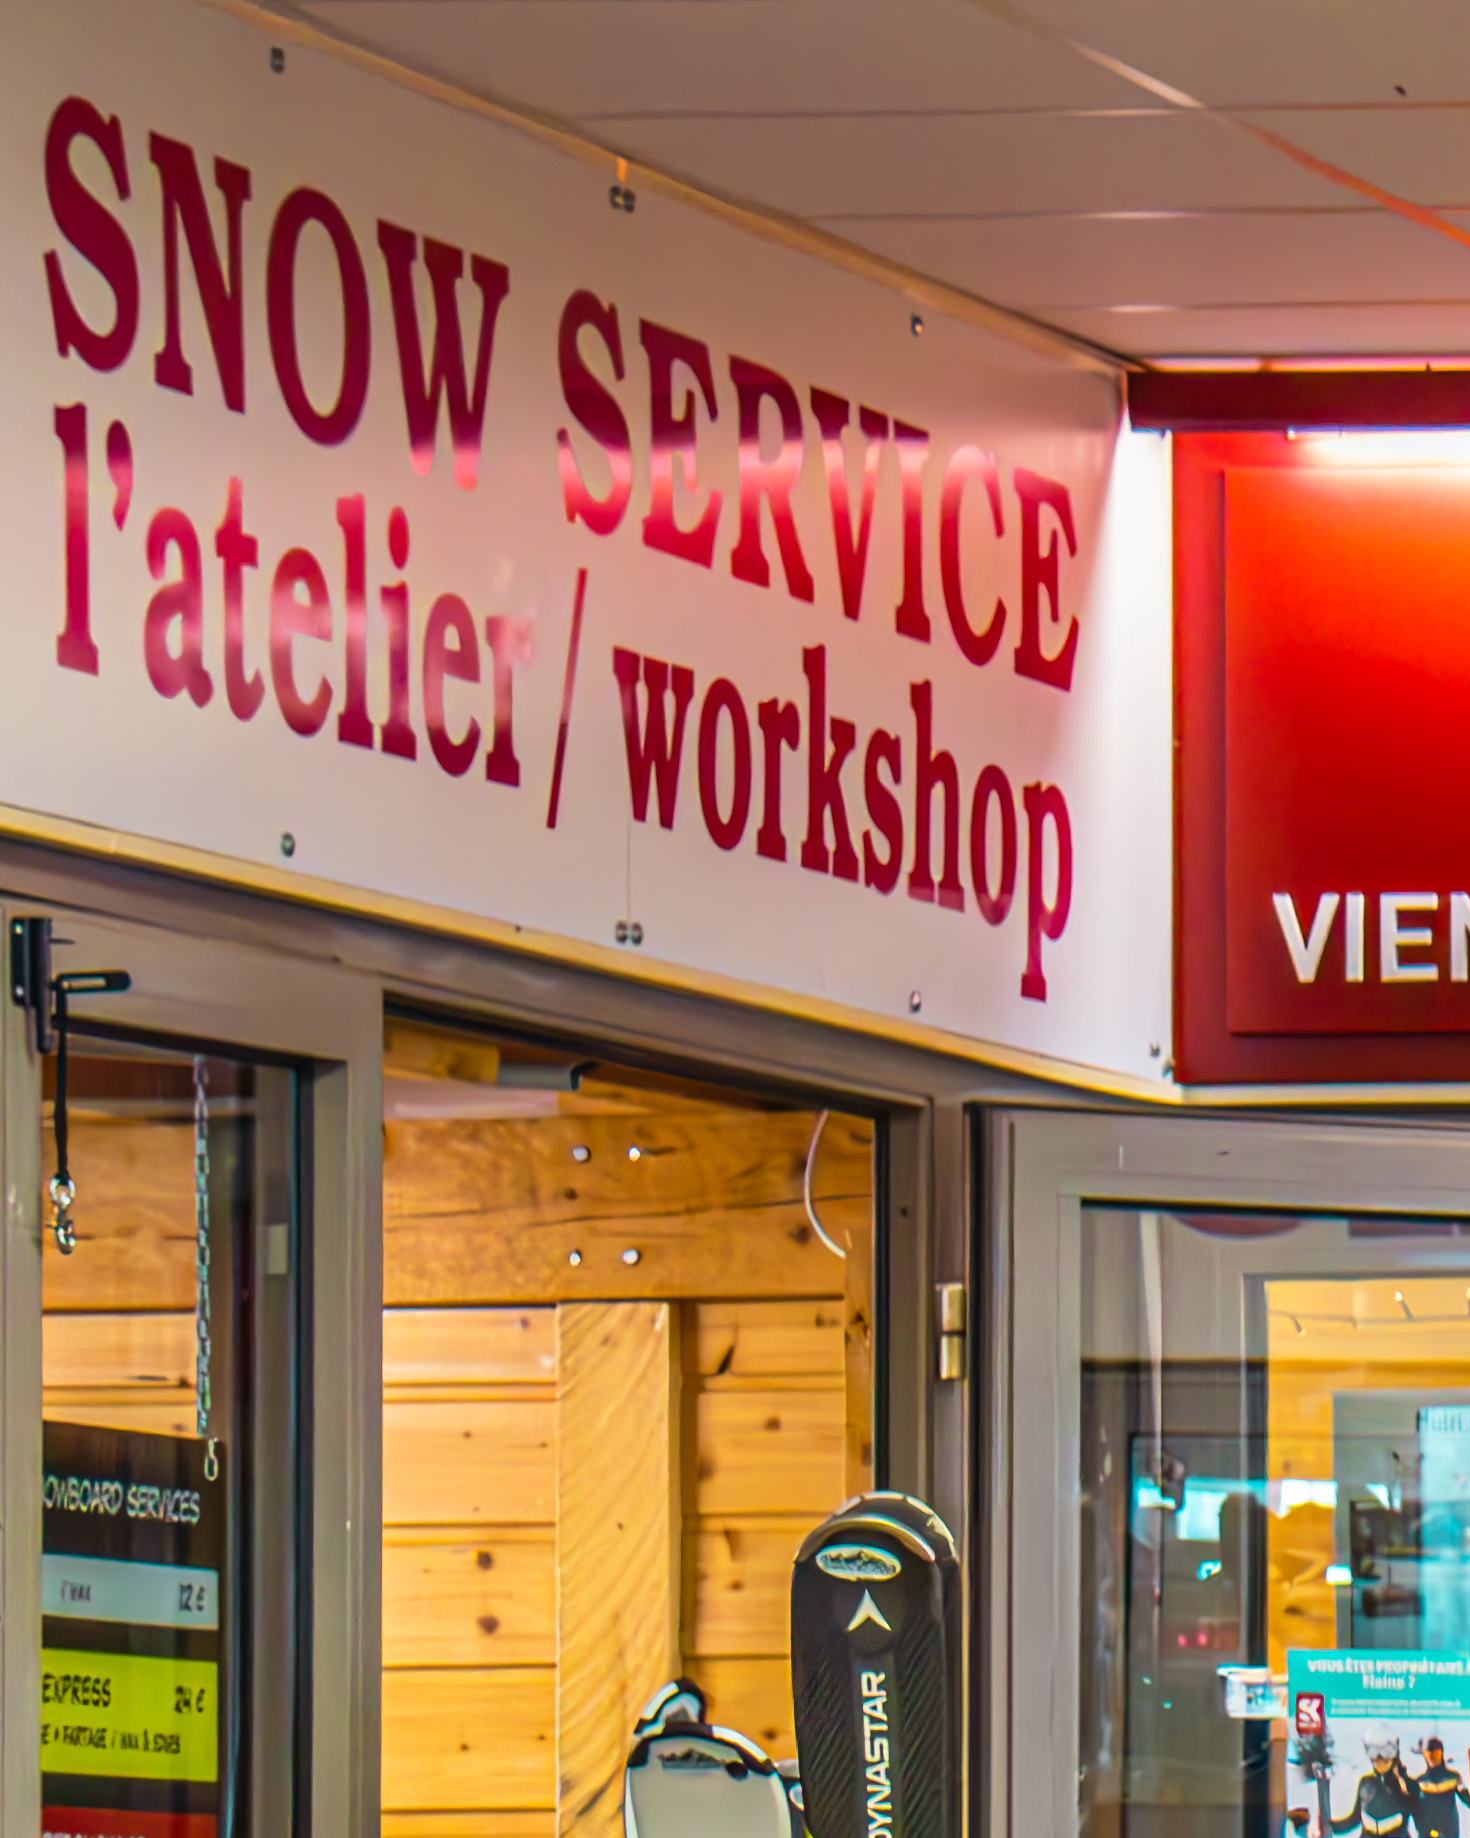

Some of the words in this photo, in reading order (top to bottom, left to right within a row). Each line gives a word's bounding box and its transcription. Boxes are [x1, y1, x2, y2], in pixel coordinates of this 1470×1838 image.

[44, 95, 509, 491] SNOW
[556, 289, 1080, 693] SERVICE
[612, 644, 1072, 1003] workshop
[126, 1484, 200, 1524] SERVICES
